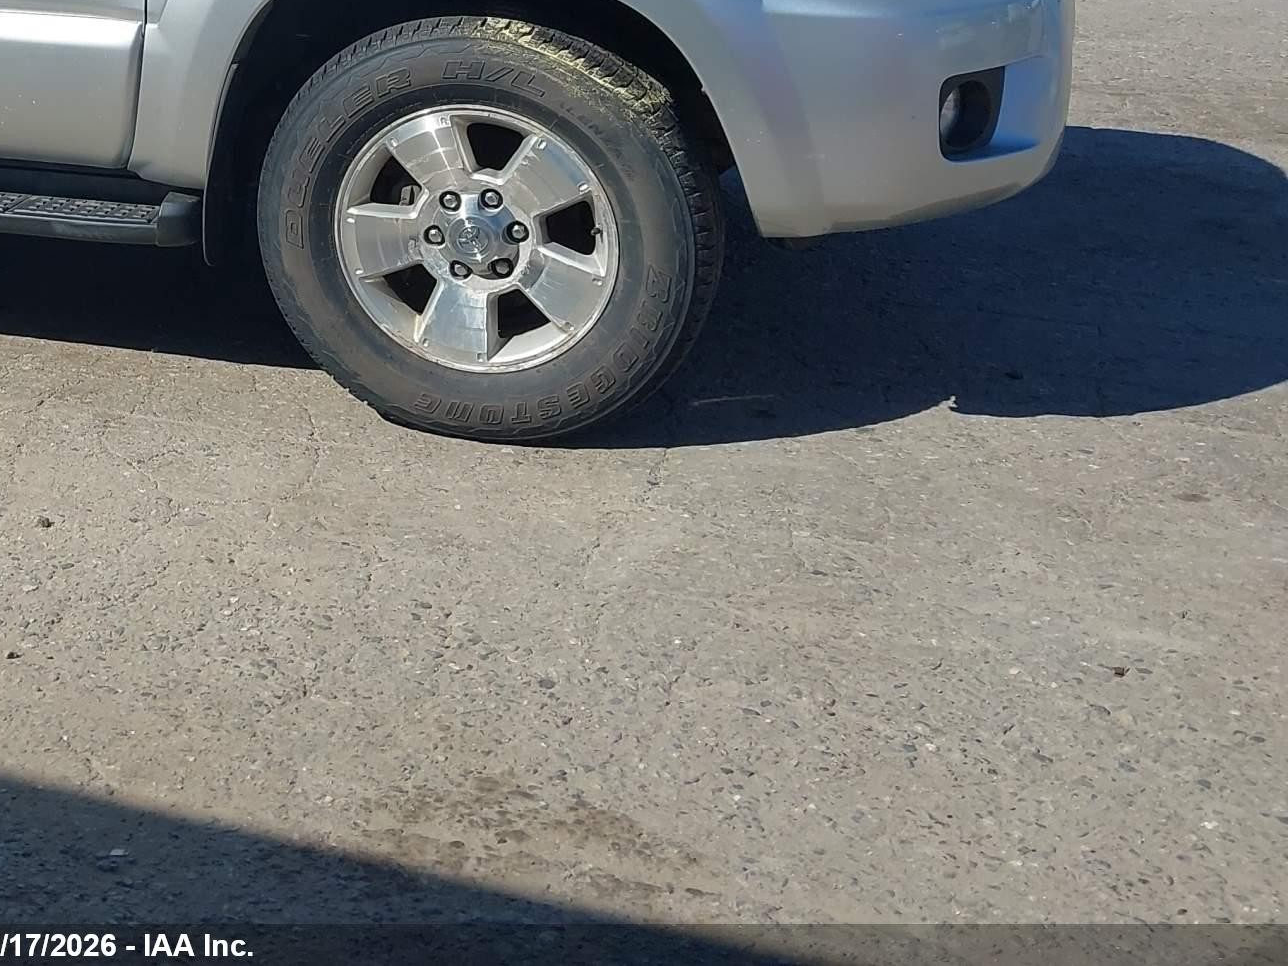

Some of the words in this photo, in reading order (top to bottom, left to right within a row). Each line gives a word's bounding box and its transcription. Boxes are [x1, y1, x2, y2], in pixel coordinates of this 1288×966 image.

[285, 69, 412, 250] DUELER
[441, 61, 546, 98] H/L
[413, 263, 672, 426] BRIDGESTONE
